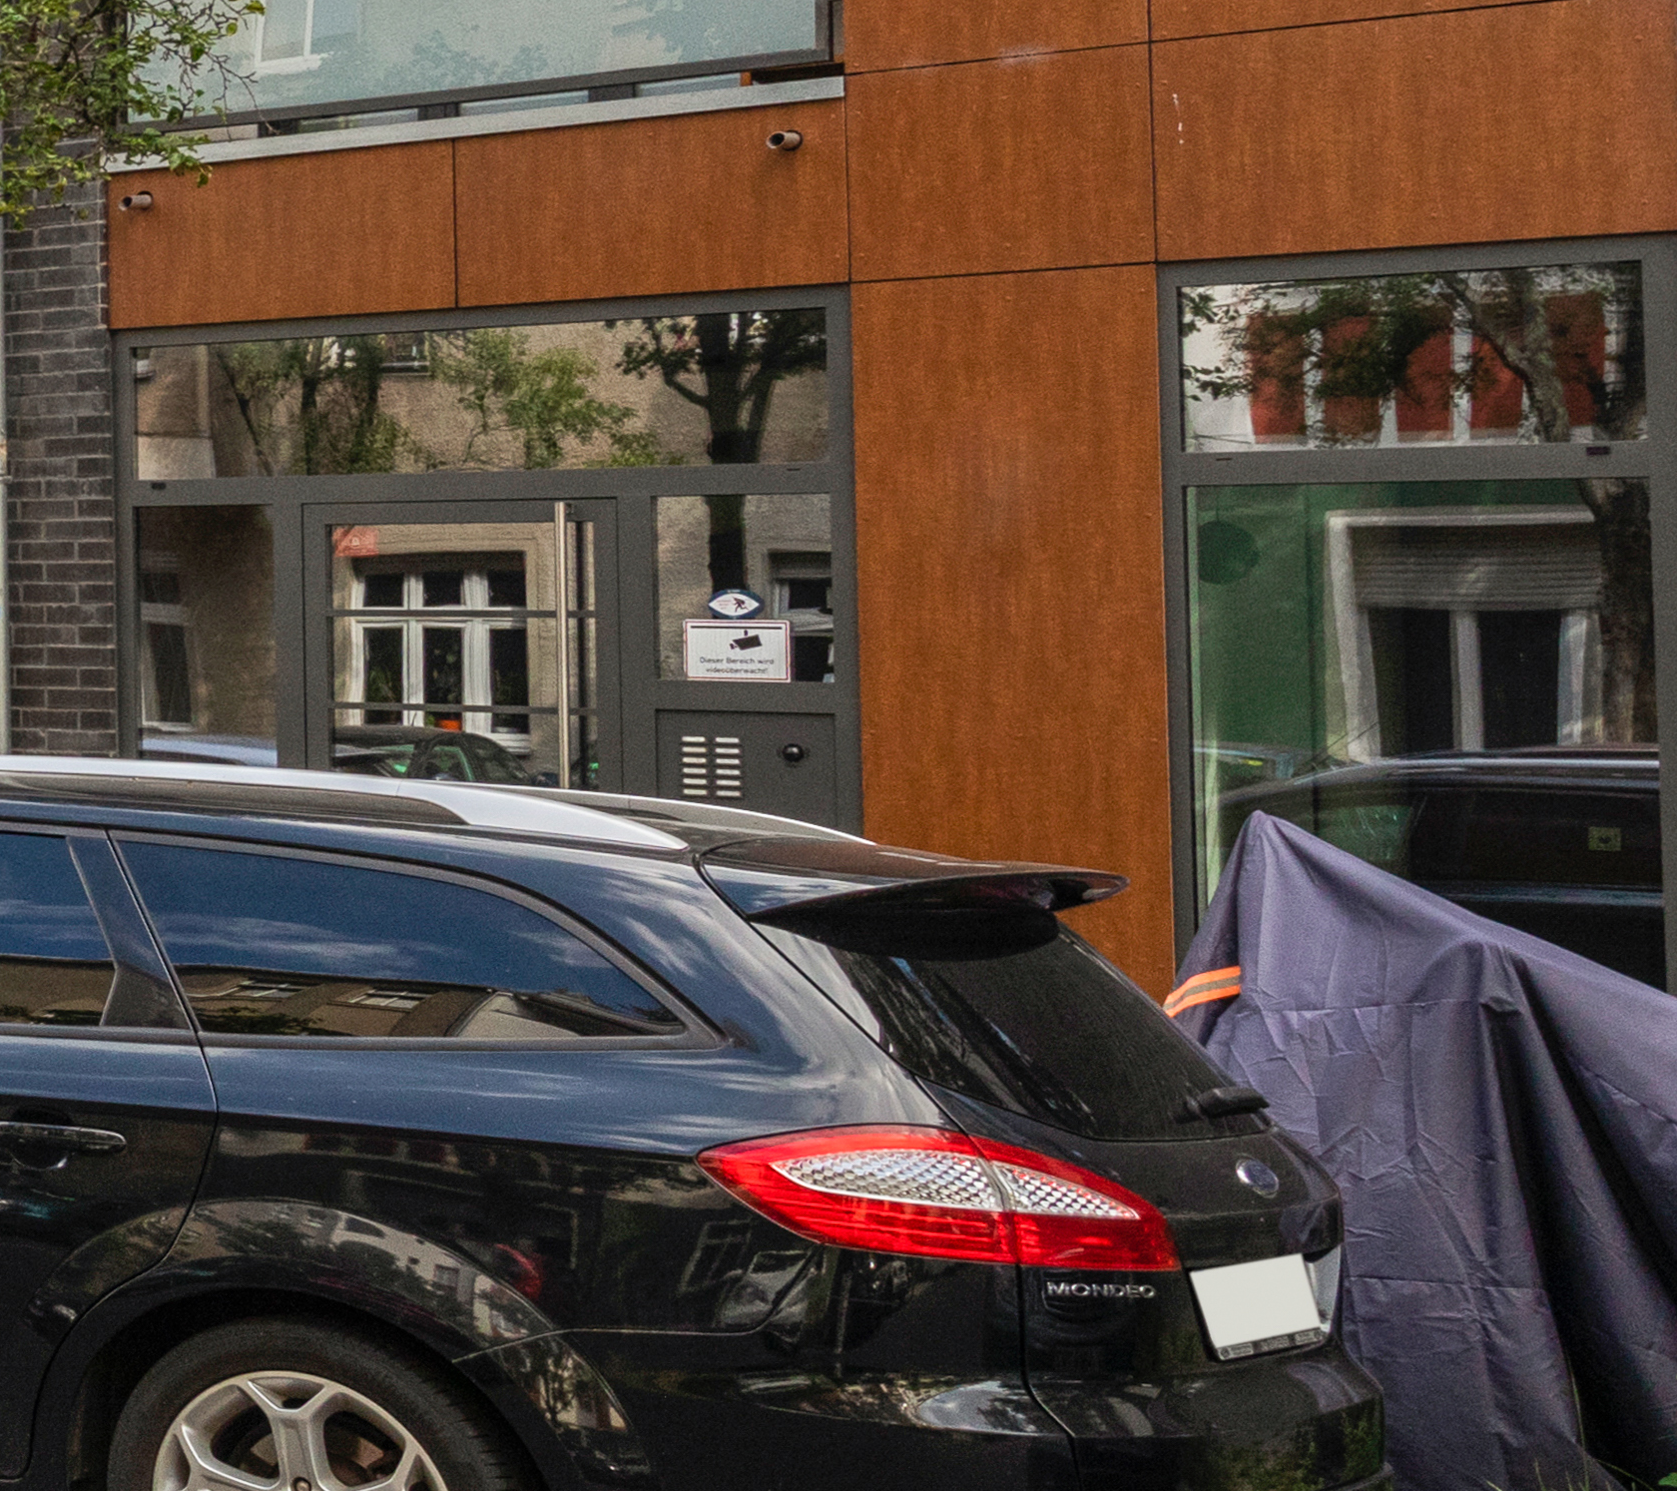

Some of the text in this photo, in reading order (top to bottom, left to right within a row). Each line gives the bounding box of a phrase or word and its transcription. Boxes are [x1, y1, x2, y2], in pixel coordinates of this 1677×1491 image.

[699, 656, 775, 665] Dieser Bereich wird
[1047, 1281, 1157, 1299] MONDEO
